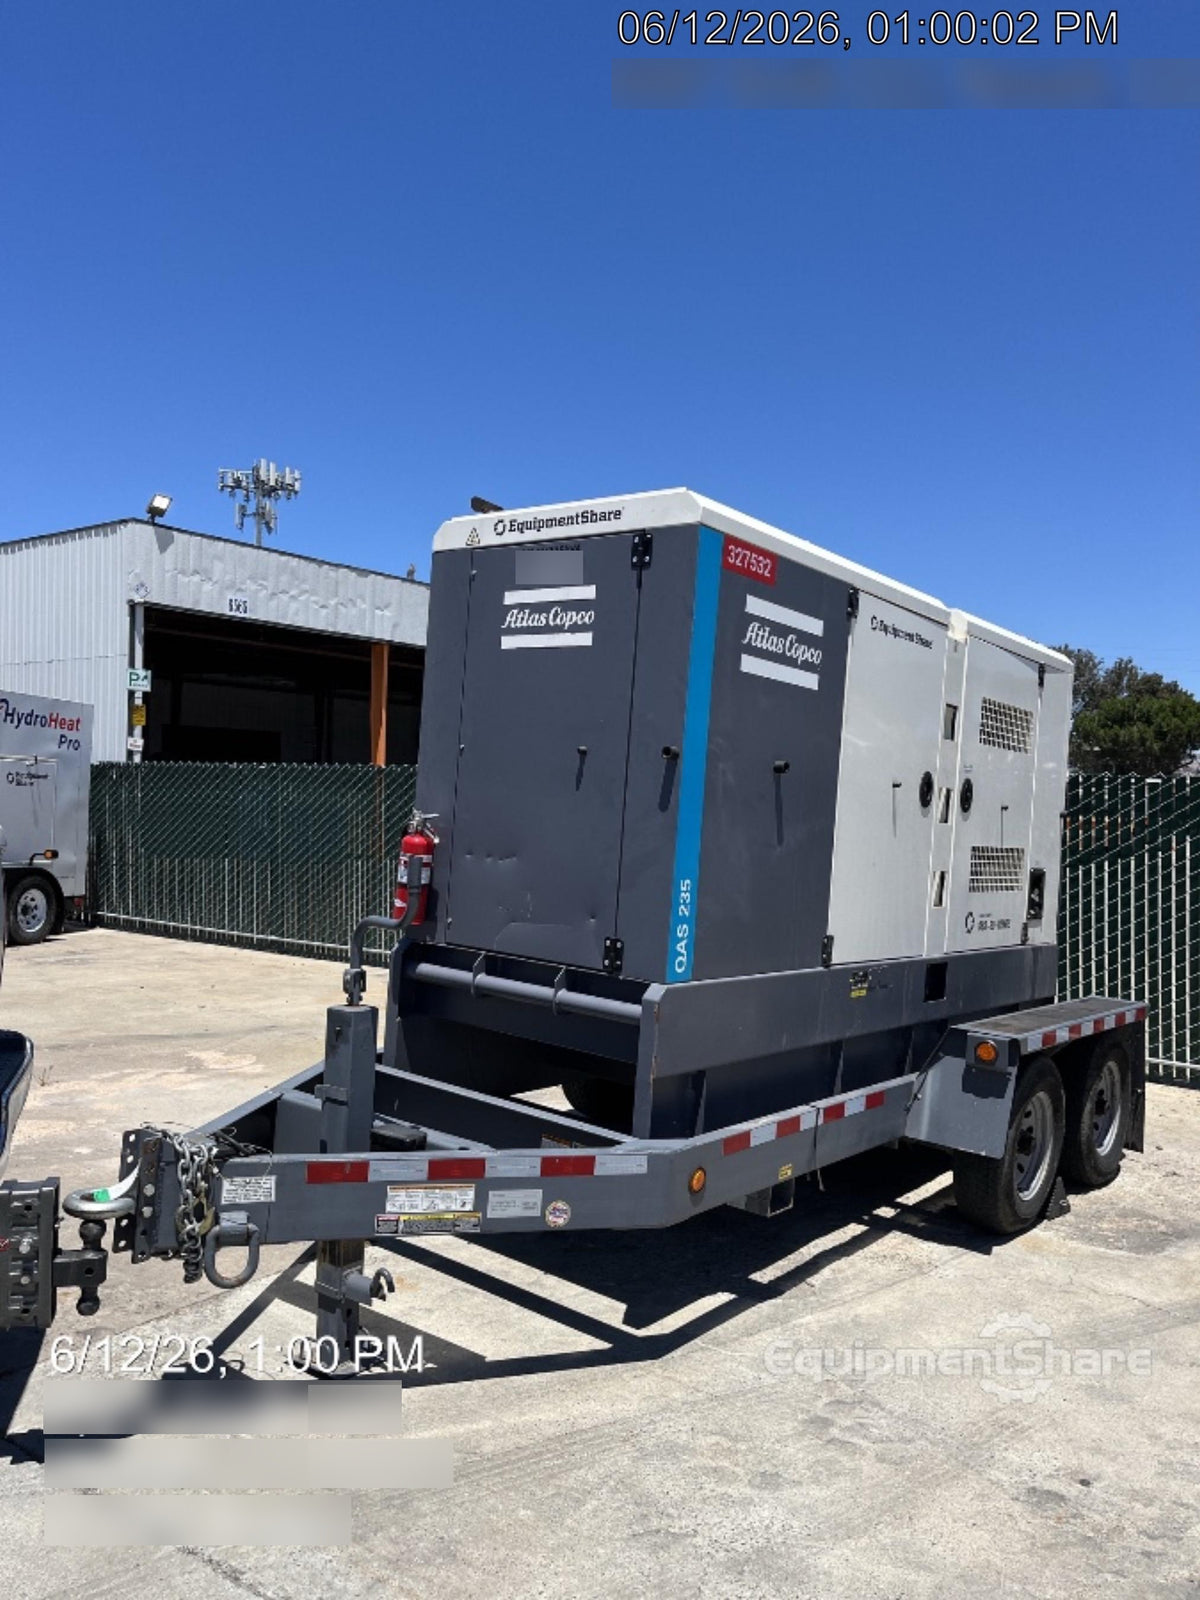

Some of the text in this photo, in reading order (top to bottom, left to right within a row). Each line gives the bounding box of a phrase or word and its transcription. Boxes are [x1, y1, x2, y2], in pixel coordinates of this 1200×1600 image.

[508, 509, 622, 534] EquipmentShare
[727, 545, 773, 577] 327532
[501, 605, 595, 630] Atlas Copco
[741, 621, 823, 665] Atlas Copco
[3, 706, 81, 732] HydroHeat
[58, 733, 81, 751] Pro
[675, 879, 691, 974] QAS 235
